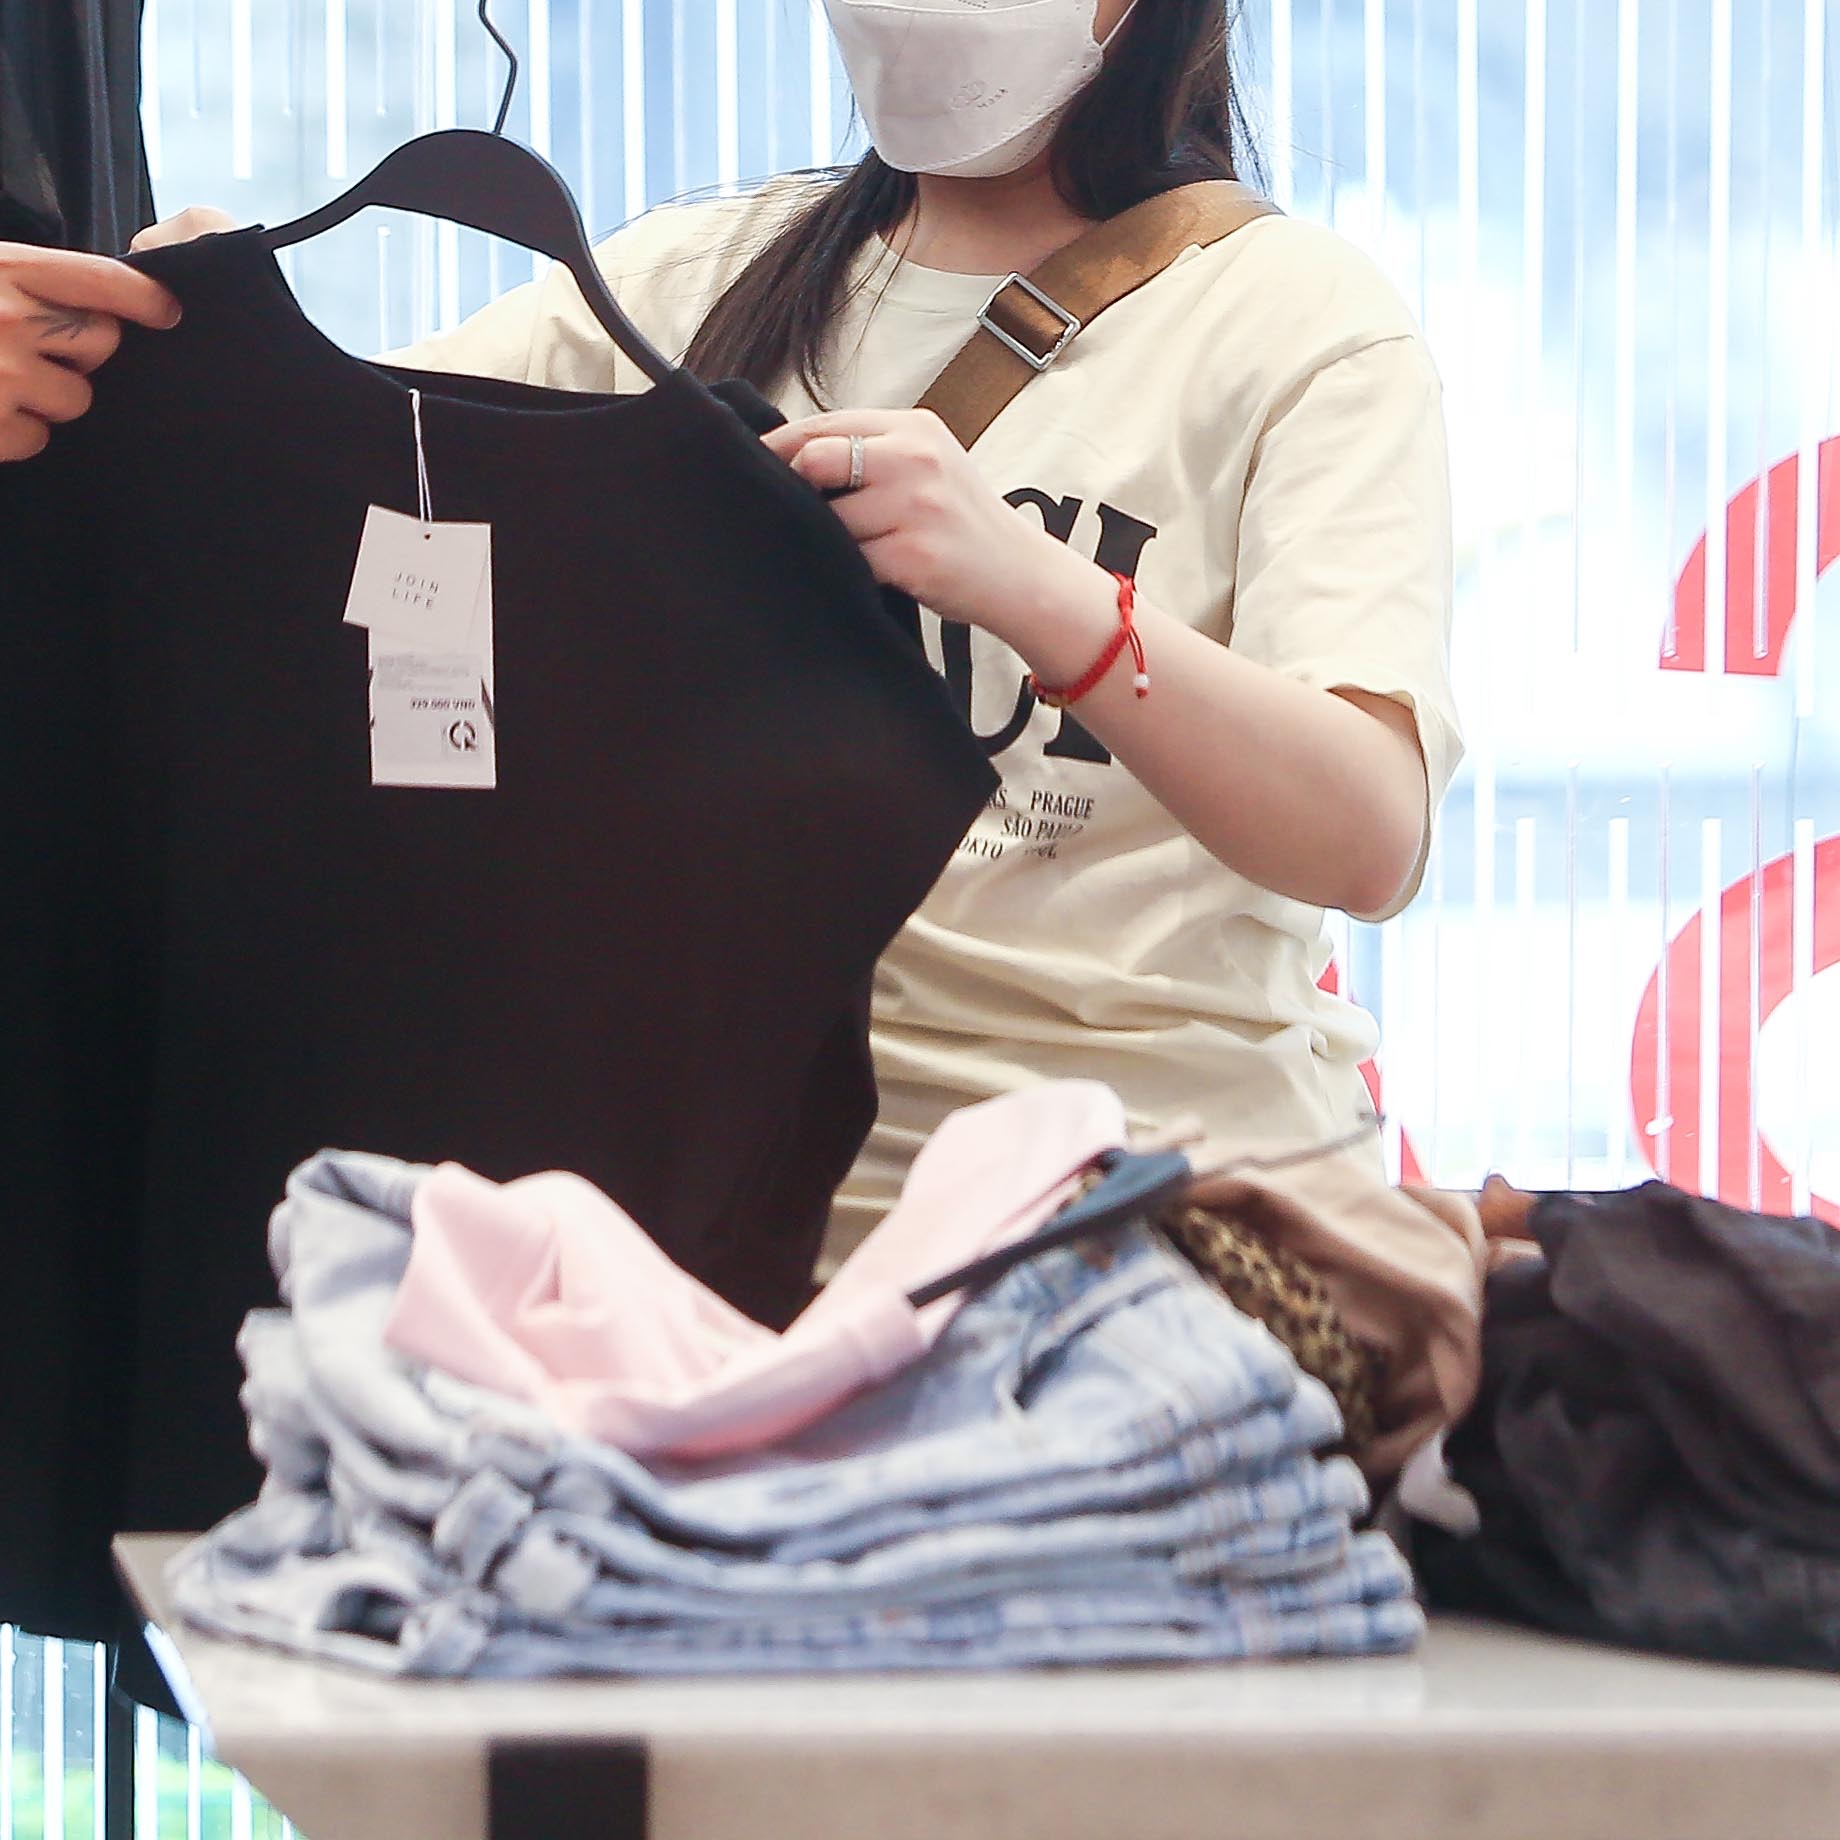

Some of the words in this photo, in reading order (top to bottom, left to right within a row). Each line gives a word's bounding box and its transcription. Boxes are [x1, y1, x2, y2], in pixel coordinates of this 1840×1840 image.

[396, 572, 439, 593] JOIN
[392, 588, 433, 609] LIFE
[1030, 790, 1095, 820] PRAGUE
